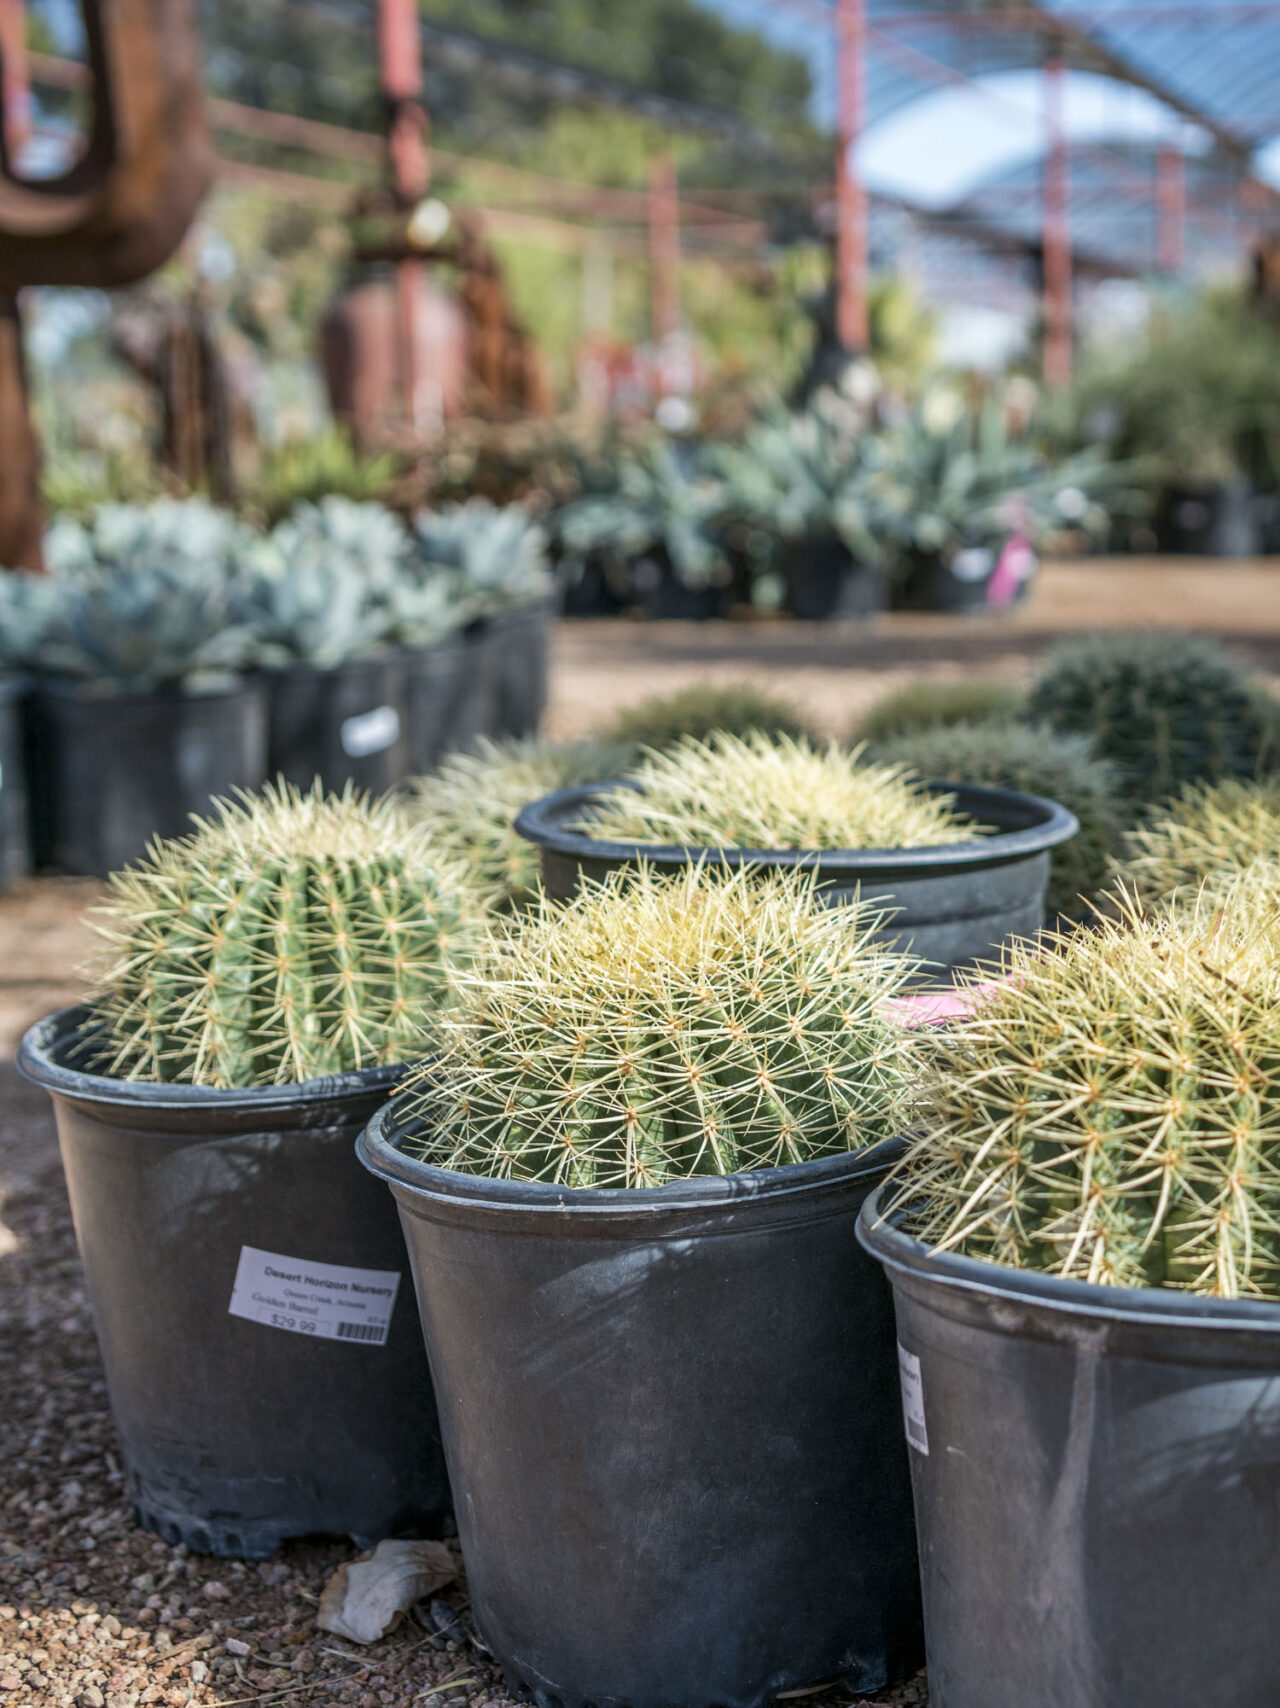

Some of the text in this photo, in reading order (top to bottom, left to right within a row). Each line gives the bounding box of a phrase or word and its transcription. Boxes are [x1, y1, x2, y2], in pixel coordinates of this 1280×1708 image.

[264, 1266, 393, 1298] Desert Horizon Nursery
[252, 1292, 319, 1316] Golden Barrel
